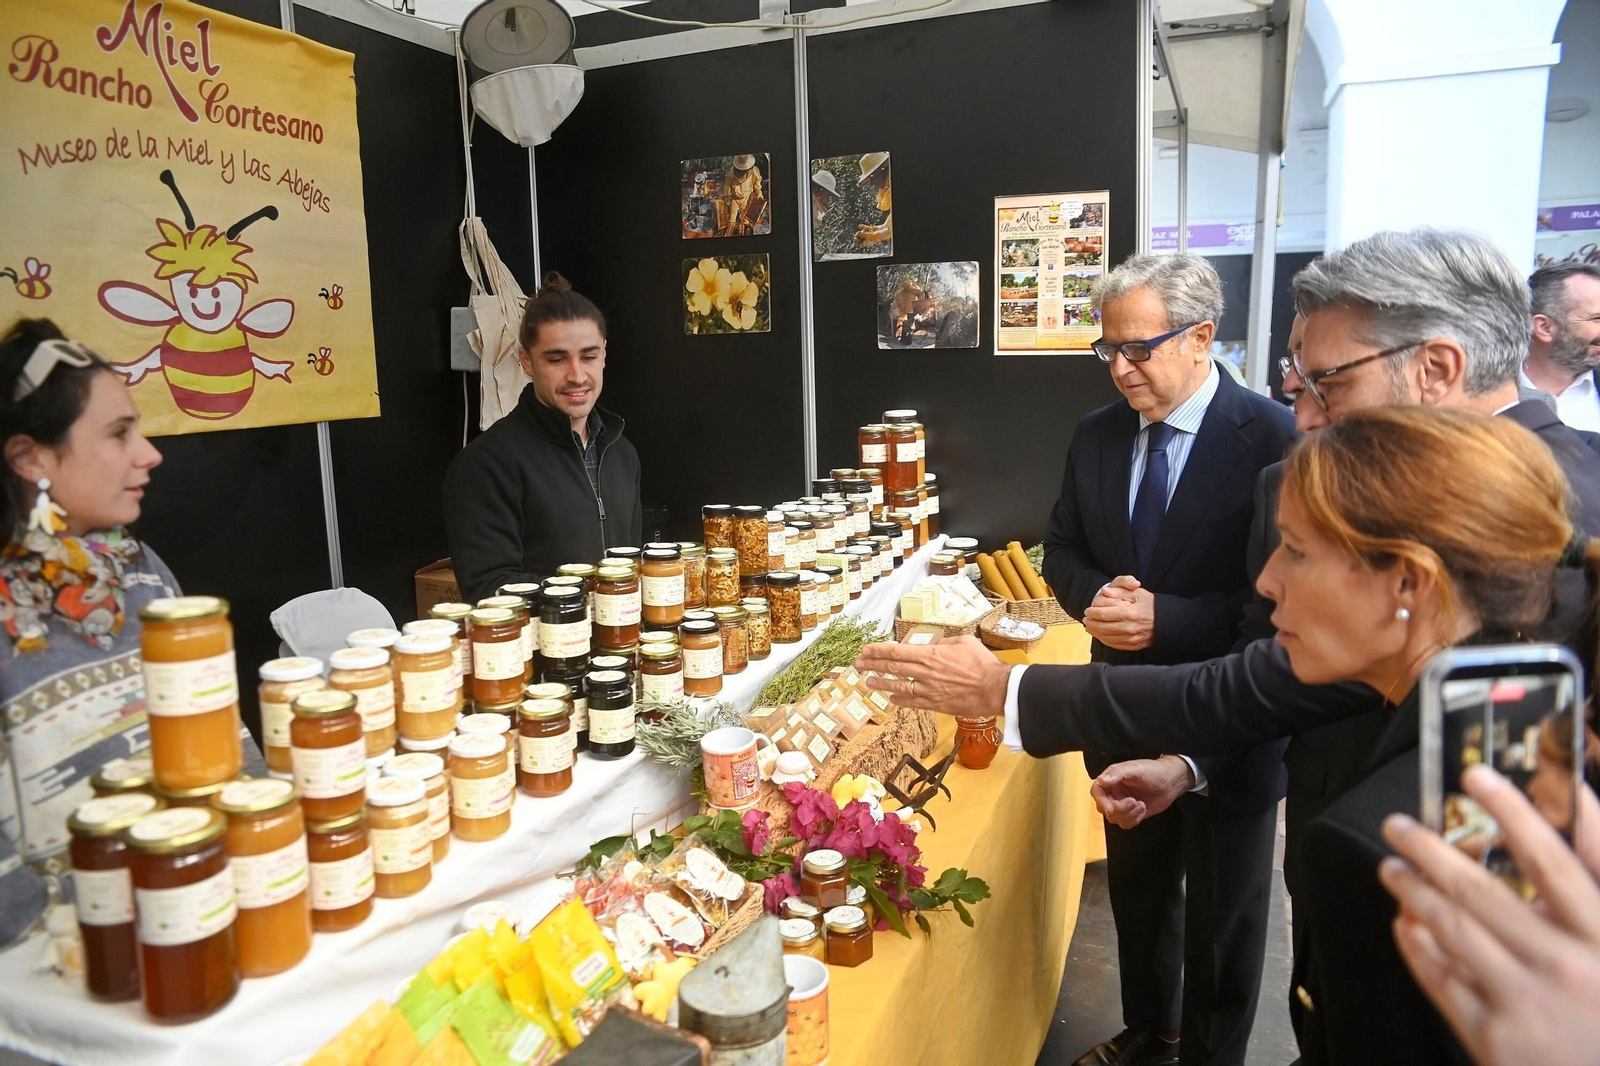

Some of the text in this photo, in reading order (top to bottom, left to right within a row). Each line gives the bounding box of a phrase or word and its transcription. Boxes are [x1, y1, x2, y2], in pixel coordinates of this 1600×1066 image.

[8, 34, 324, 144] Rancho Cortesano
[96, 0, 220, 122] Miel
[18, 127, 330, 213] Museo de la Miel y las Abejas
[1000, 221, 1067, 232] Rancho Cortesano
[1016, 211, 1040, 231] Miel
